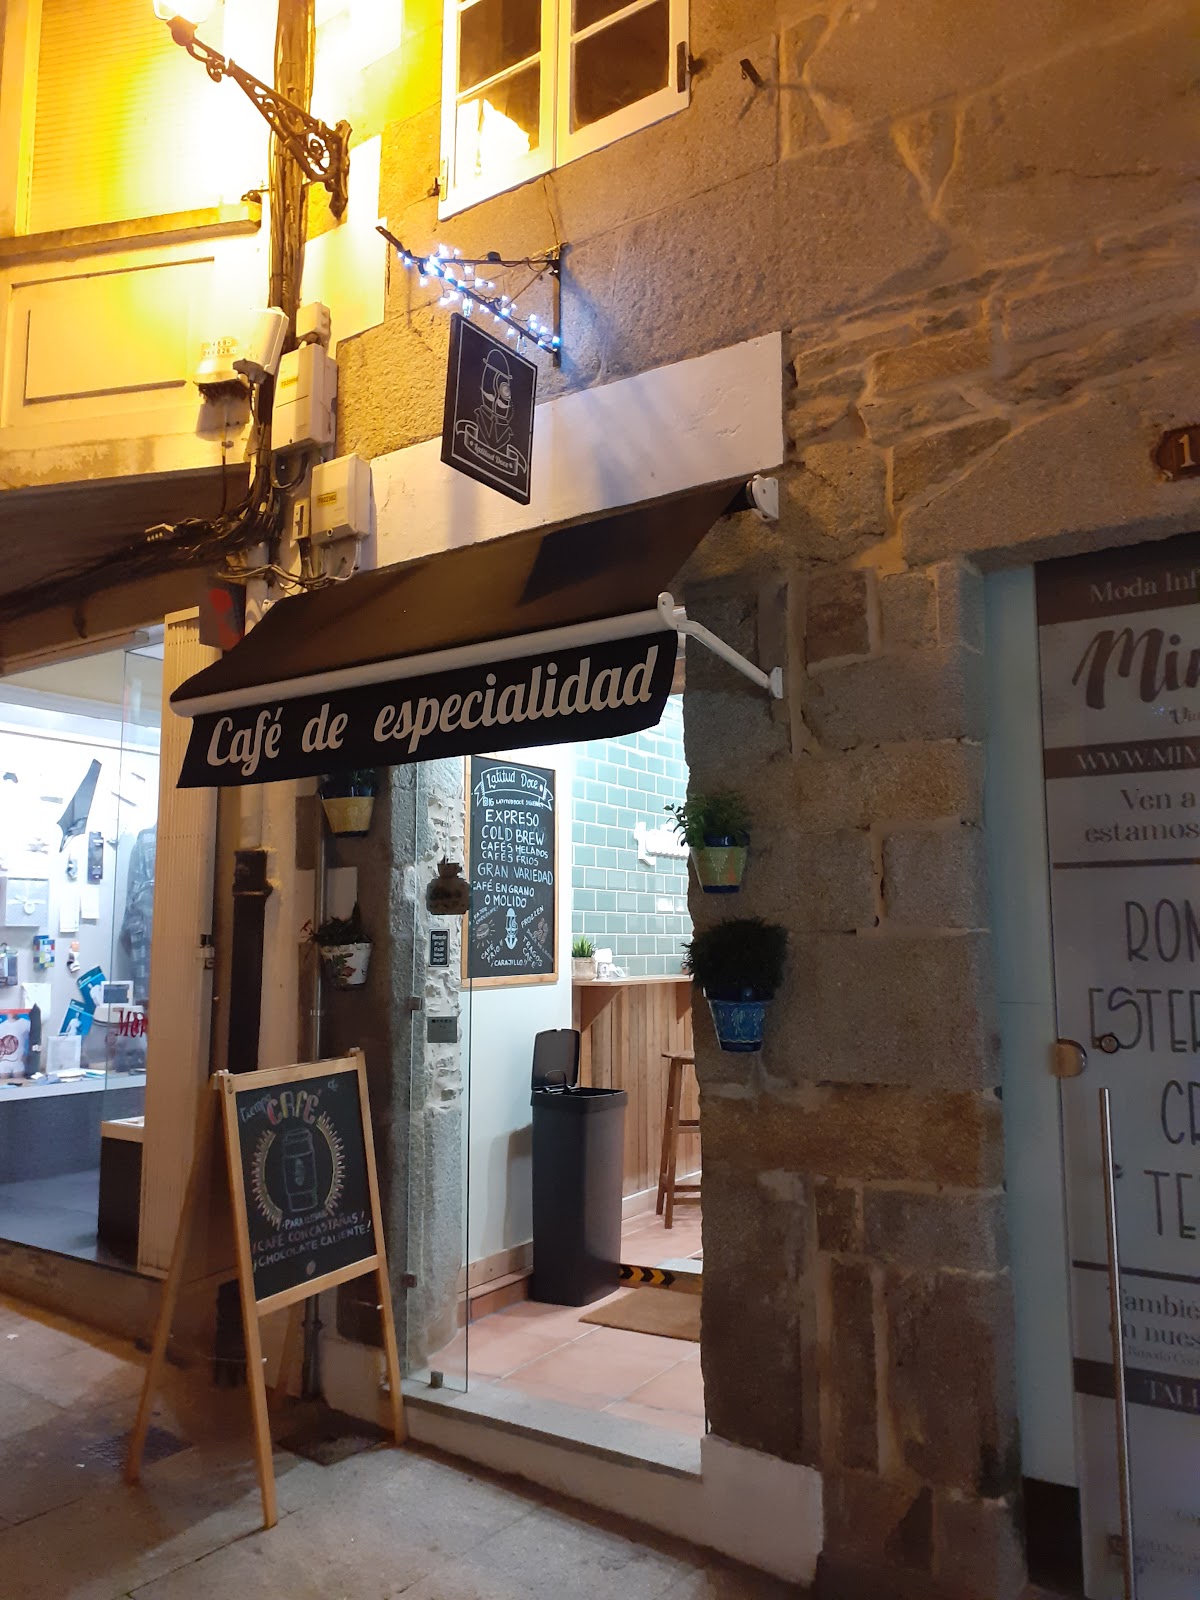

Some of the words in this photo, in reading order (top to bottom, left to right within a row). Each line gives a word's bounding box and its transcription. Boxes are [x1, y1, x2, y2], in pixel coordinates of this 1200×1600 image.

[1178, 434, 1196, 467] 1
[1088, 576, 1158, 603] Moda
[206, 706, 284, 777] Café
[301, 703, 348, 754] de
[373, 645, 660, 754] especialidad
[486, 770, 516, 789] Latitud
[520, 773, 538, 790] Doce
[1120, 788, 1171, 811] Ven
[1181, 791, 1196, 808] a
[485, 809, 540, 827] EXPRESO
[481, 824, 513, 842] COLD
[515, 828, 545, 846] BREW
[1084, 821, 1200, 843] estamos
[480, 840, 513, 853] CAFÉS
[515, 844, 549, 860] HELADOS
[516, 855, 539, 867] FRIOS
[477, 862, 509, 879] GRAN
[513, 866, 554, 886] VARIEDAD
[495, 882, 508, 894] EN
[508, 884, 535, 898] GRANO
[484, 894, 491, 905] O
[493, 894, 527, 909] MOLIDO
